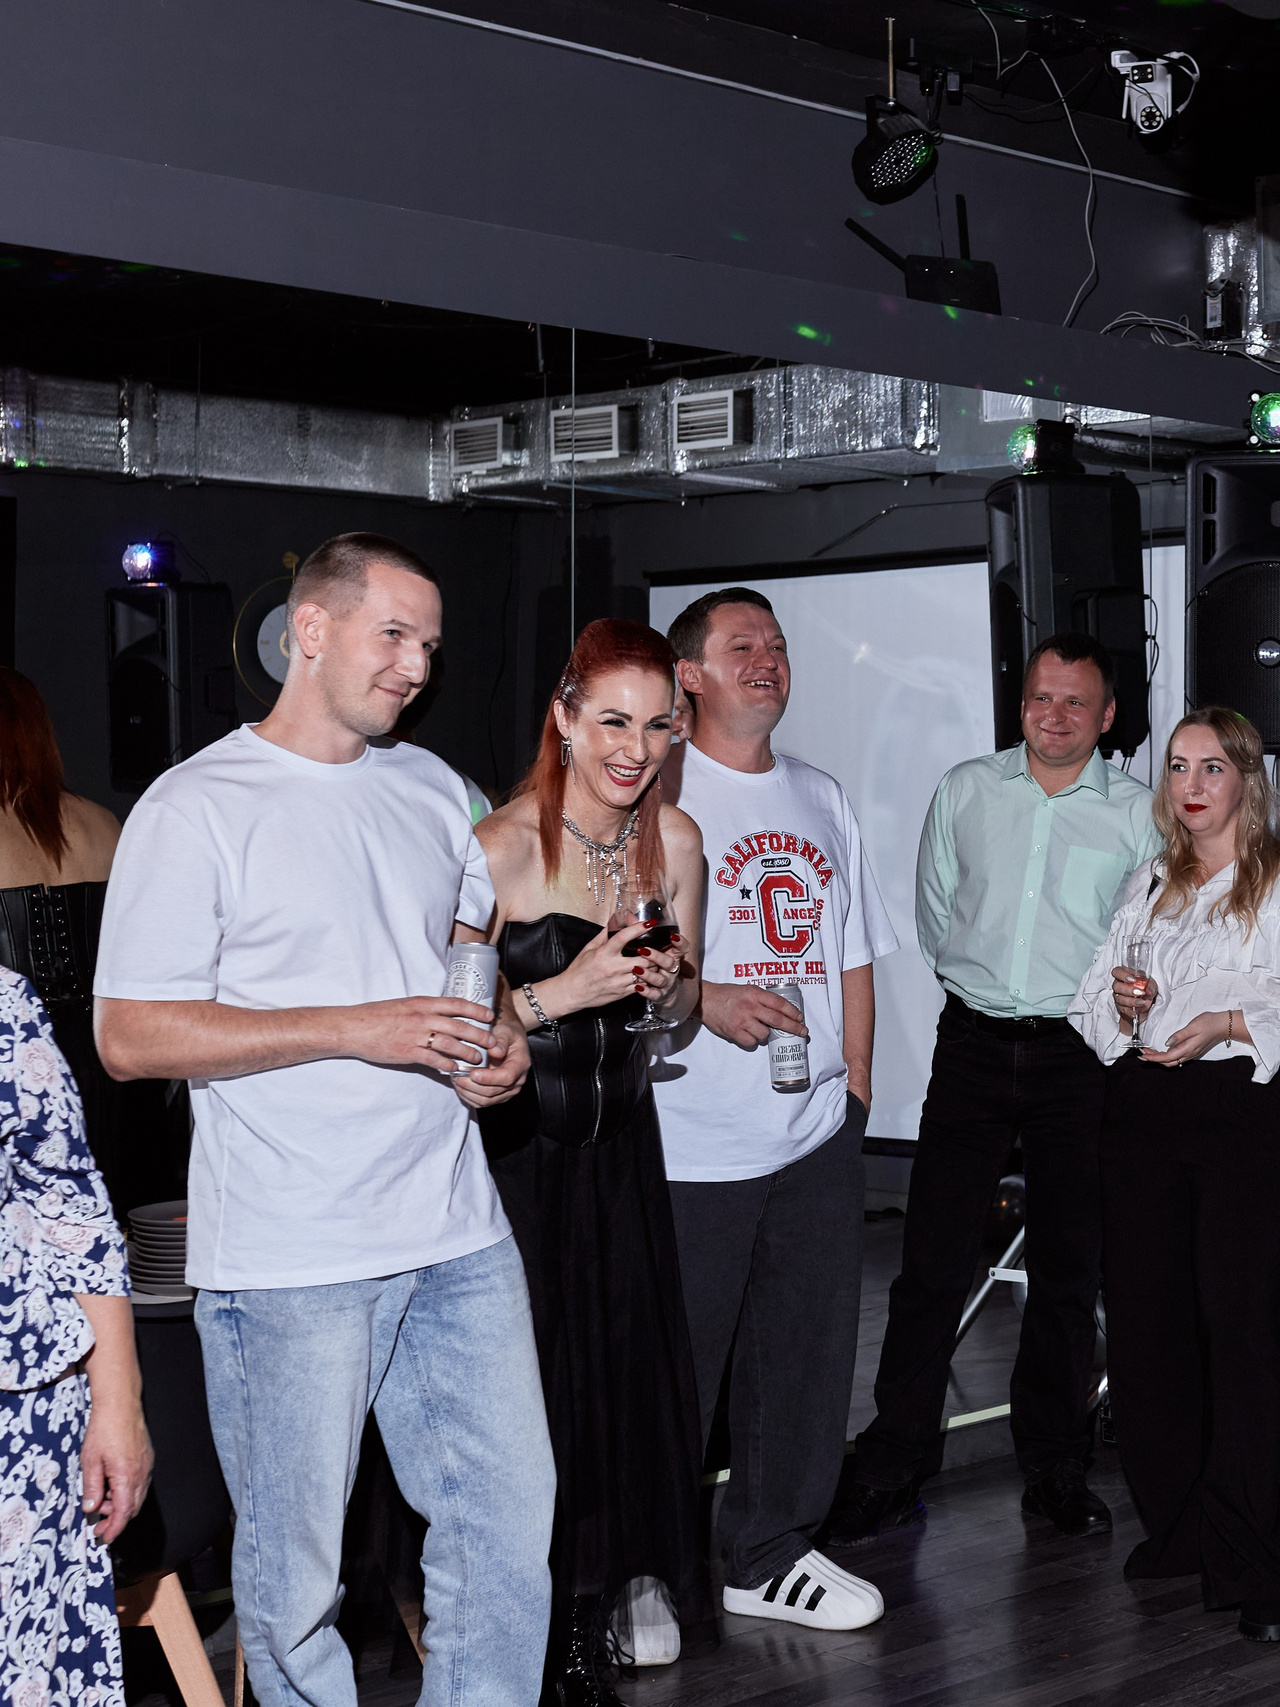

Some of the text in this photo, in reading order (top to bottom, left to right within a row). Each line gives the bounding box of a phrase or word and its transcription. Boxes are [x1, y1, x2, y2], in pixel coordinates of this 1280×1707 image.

[716, 832, 833, 888] CALIFORNIA
[729, 910, 756, 921] 3301
[734, 961, 799, 977] BEVERLY
